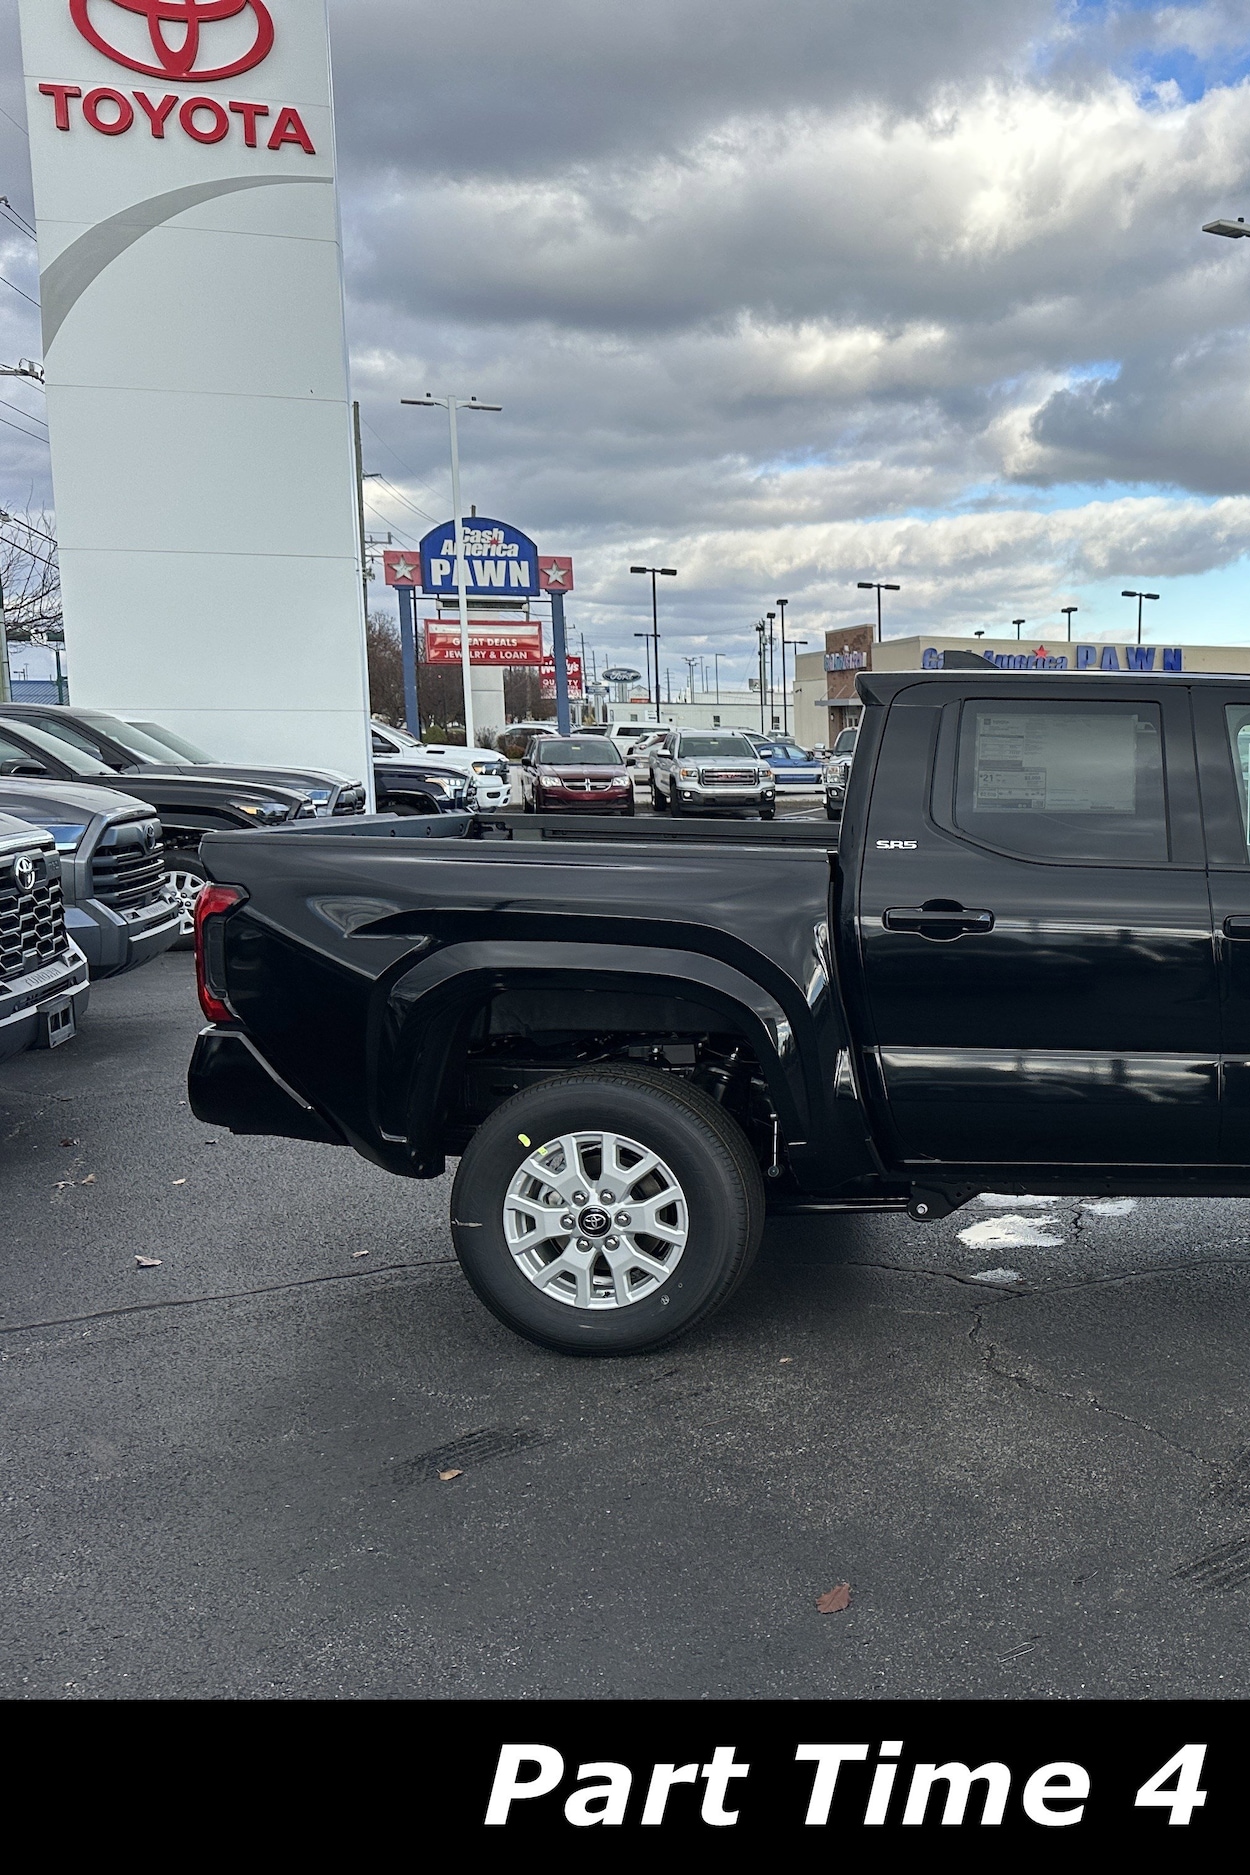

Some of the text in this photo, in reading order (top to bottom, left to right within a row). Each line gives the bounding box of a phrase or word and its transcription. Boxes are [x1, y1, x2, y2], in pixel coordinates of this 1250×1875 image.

[38, 83, 316, 155] TOYOTA
[461, 526, 505, 544] Cash
[430, 558, 531, 588] PAWN
[452, 637, 517, 647] GEAT DEALS
[444, 650, 527, 660] JEWLRY & LOAN
[1076, 645, 1183, 671] PAWN
[610, 670, 633, 681] Ford
[876, 840, 918, 849] SR5
